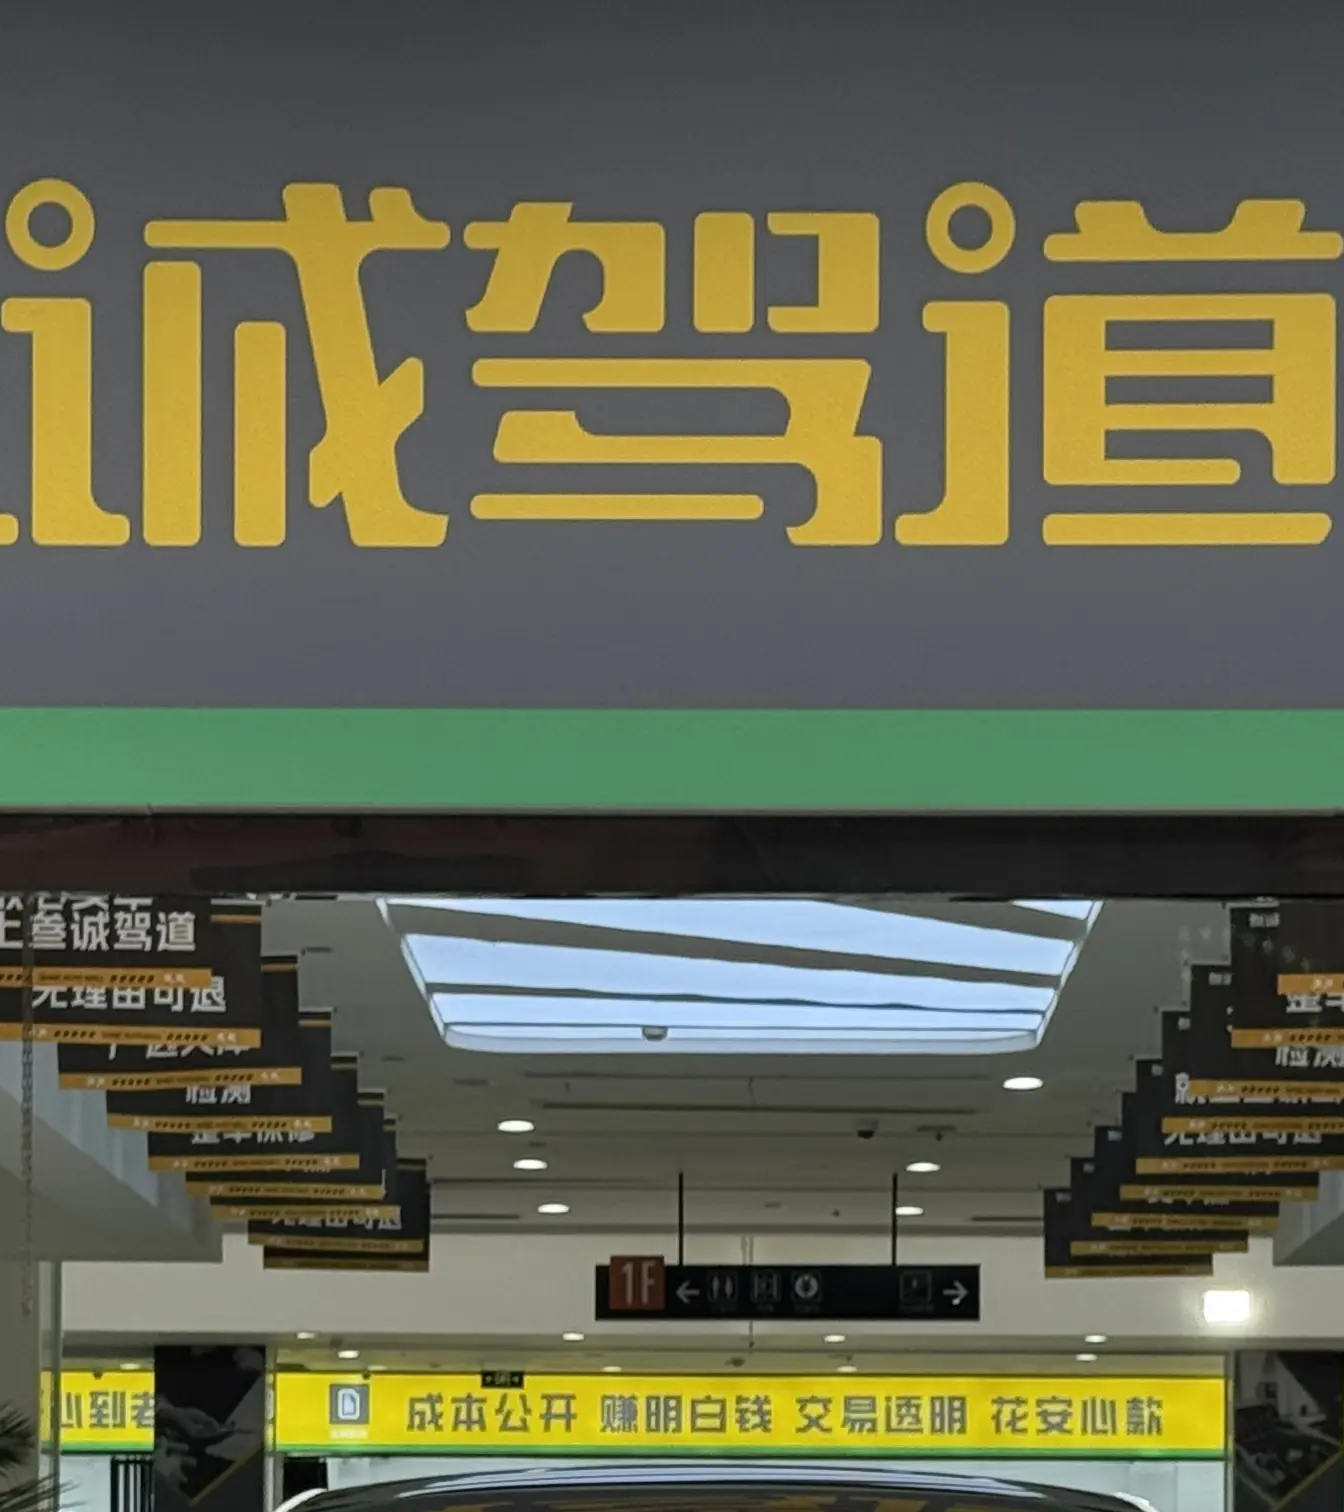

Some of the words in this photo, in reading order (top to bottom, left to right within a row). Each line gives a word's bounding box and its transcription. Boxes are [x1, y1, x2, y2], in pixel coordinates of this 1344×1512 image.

[620, 1260, 657, 1306] 1F
[406, 1392, 579, 1433] 成本公开
[599, 1394, 773, 1434] 赚明白钱
[794, 1395, 967, 1435] 交易透明
[990, 1395, 1164, 1436] 花安心款
